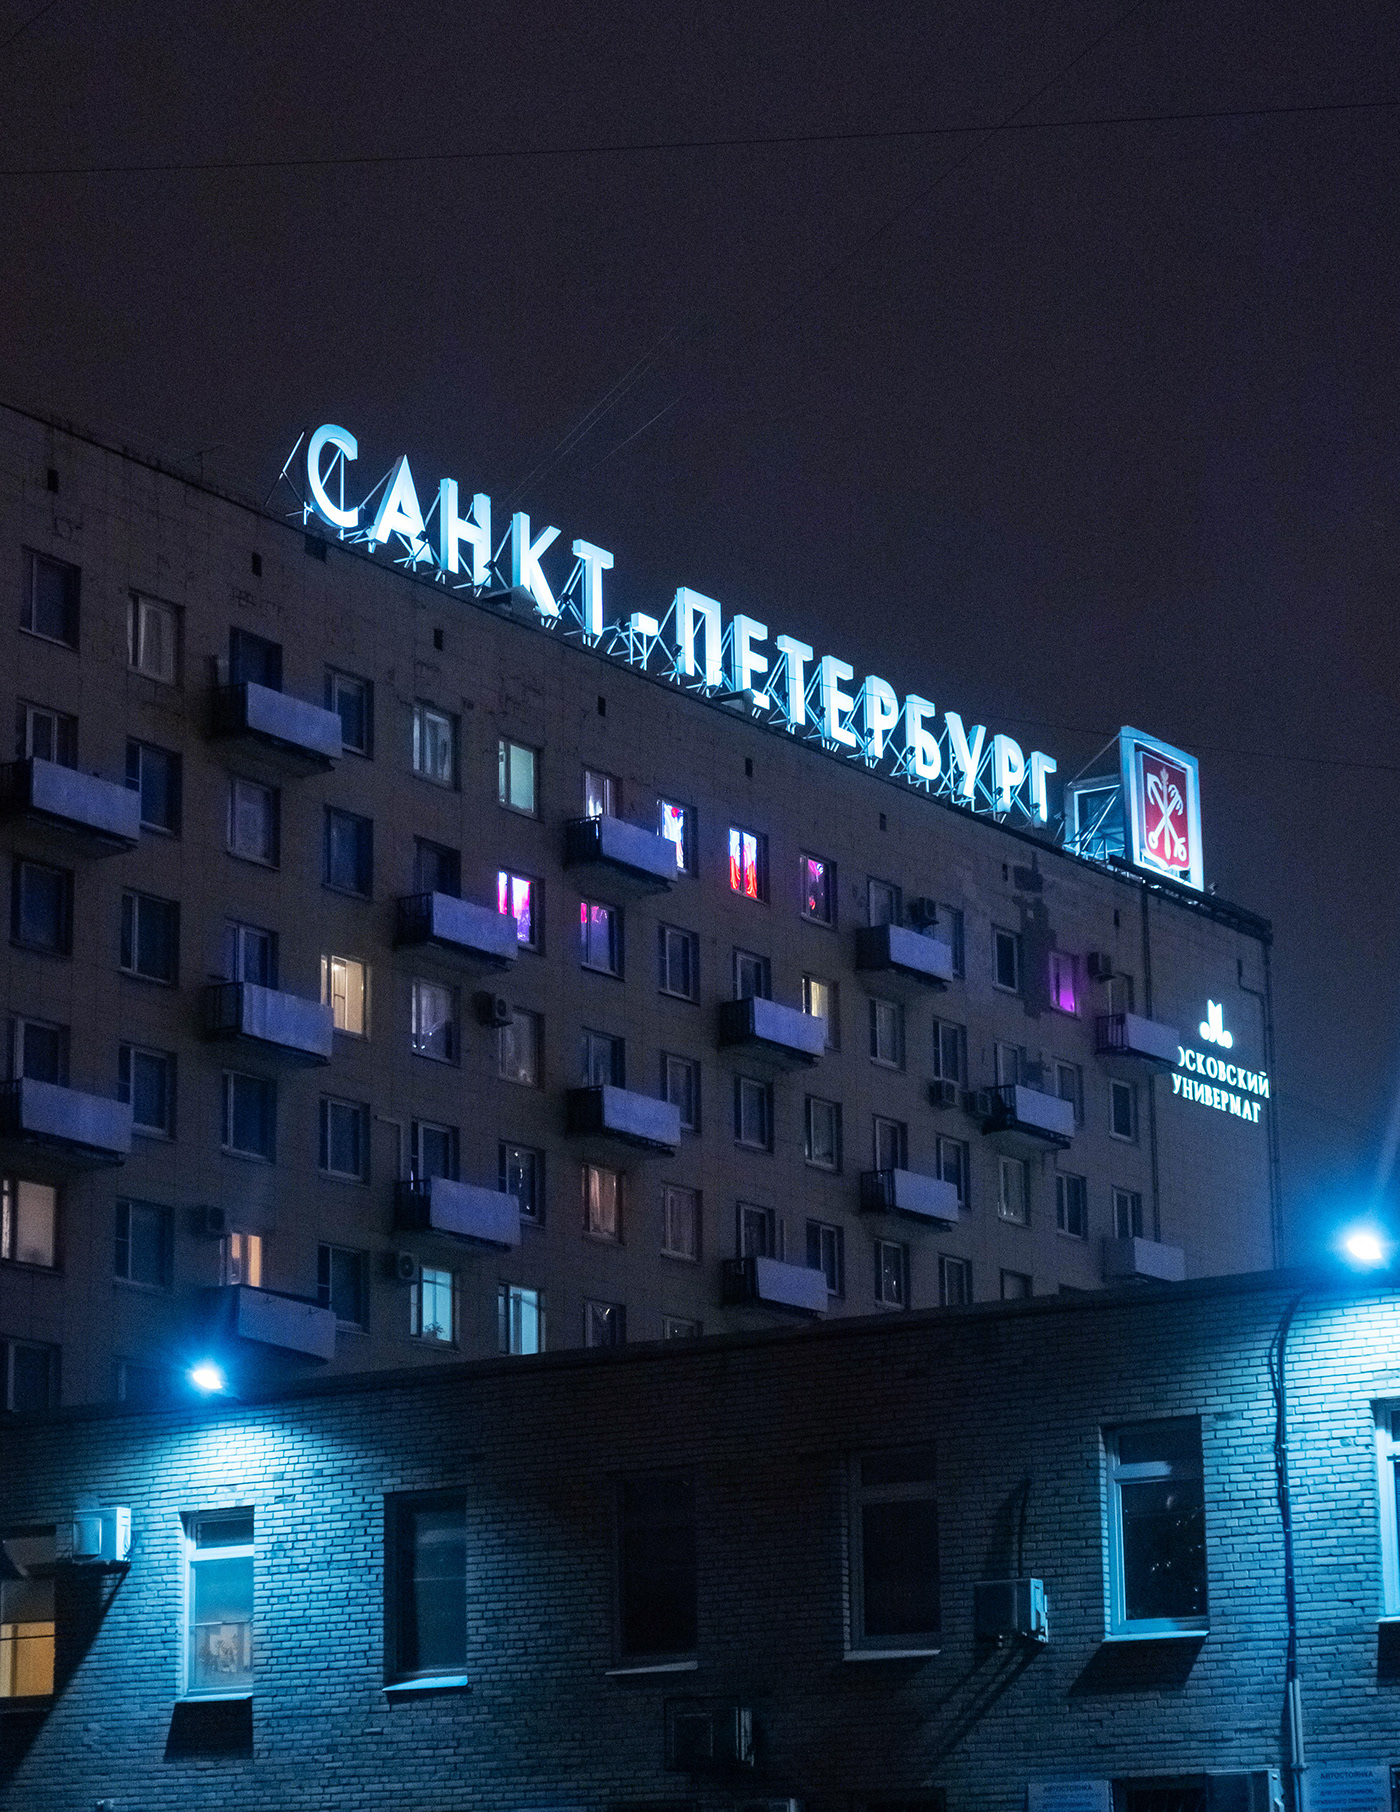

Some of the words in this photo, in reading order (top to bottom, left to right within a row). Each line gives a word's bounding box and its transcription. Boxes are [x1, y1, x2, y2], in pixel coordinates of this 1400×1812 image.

[307, 423, 1058, 824] САНКТ-ПЕТЕРБУРГ
[1171, 1072, 1262, 1123] УНИВЕРМАГ
[1177, 1046, 1270, 1099] ОСКОВСКИЙ
